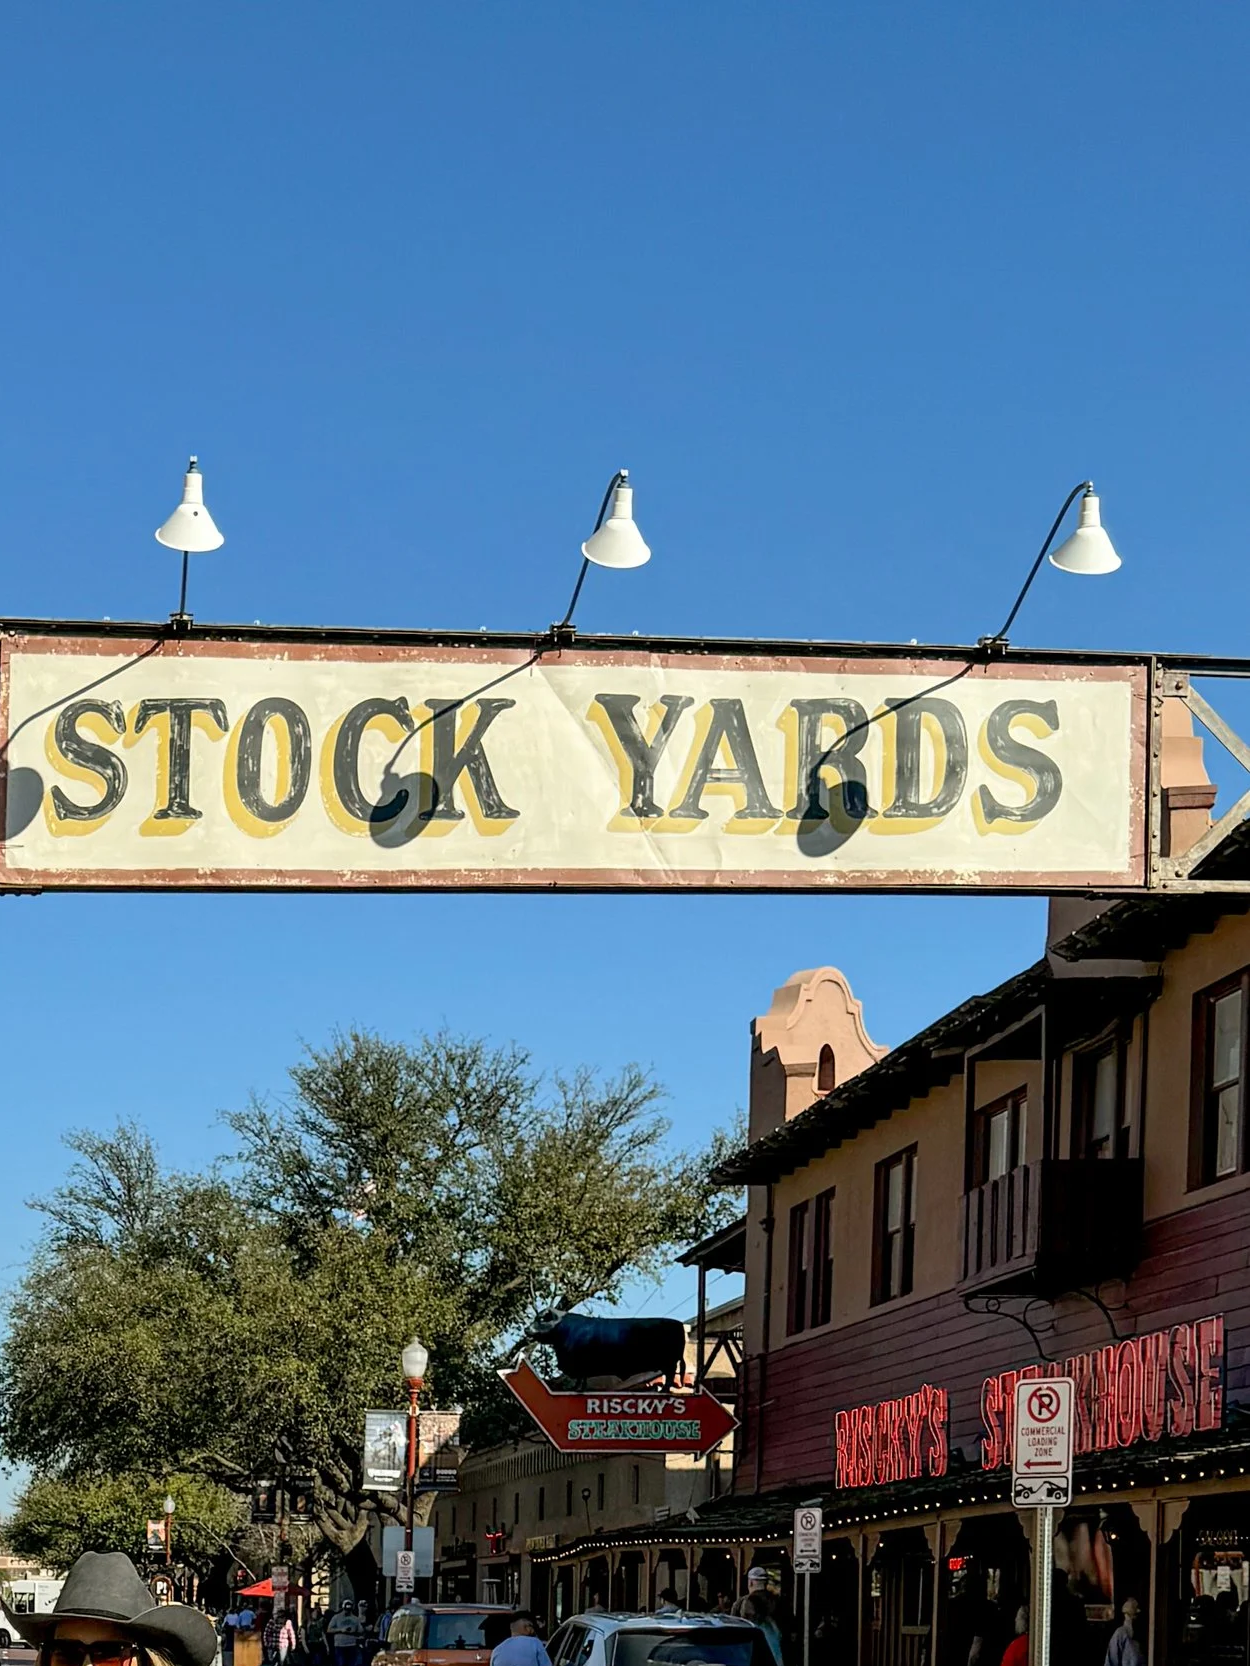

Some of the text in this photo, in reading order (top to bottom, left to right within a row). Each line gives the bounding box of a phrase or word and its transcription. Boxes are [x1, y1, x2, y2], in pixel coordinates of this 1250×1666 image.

[47, 696, 521, 830] STOCK
[590, 693, 1063, 828] YARDS
[586, 1397, 687, 1415] RISCKY'S
[567, 1419, 701, 1440] STEAKHOUSE
[835, 1383, 948, 1489] RISCKY'S
[1021, 1426, 1066, 1437] COMMERCIAL
[1027, 1437, 1058, 1447] LOADING
[1034, 1447, 1053, 1457] ZONE
